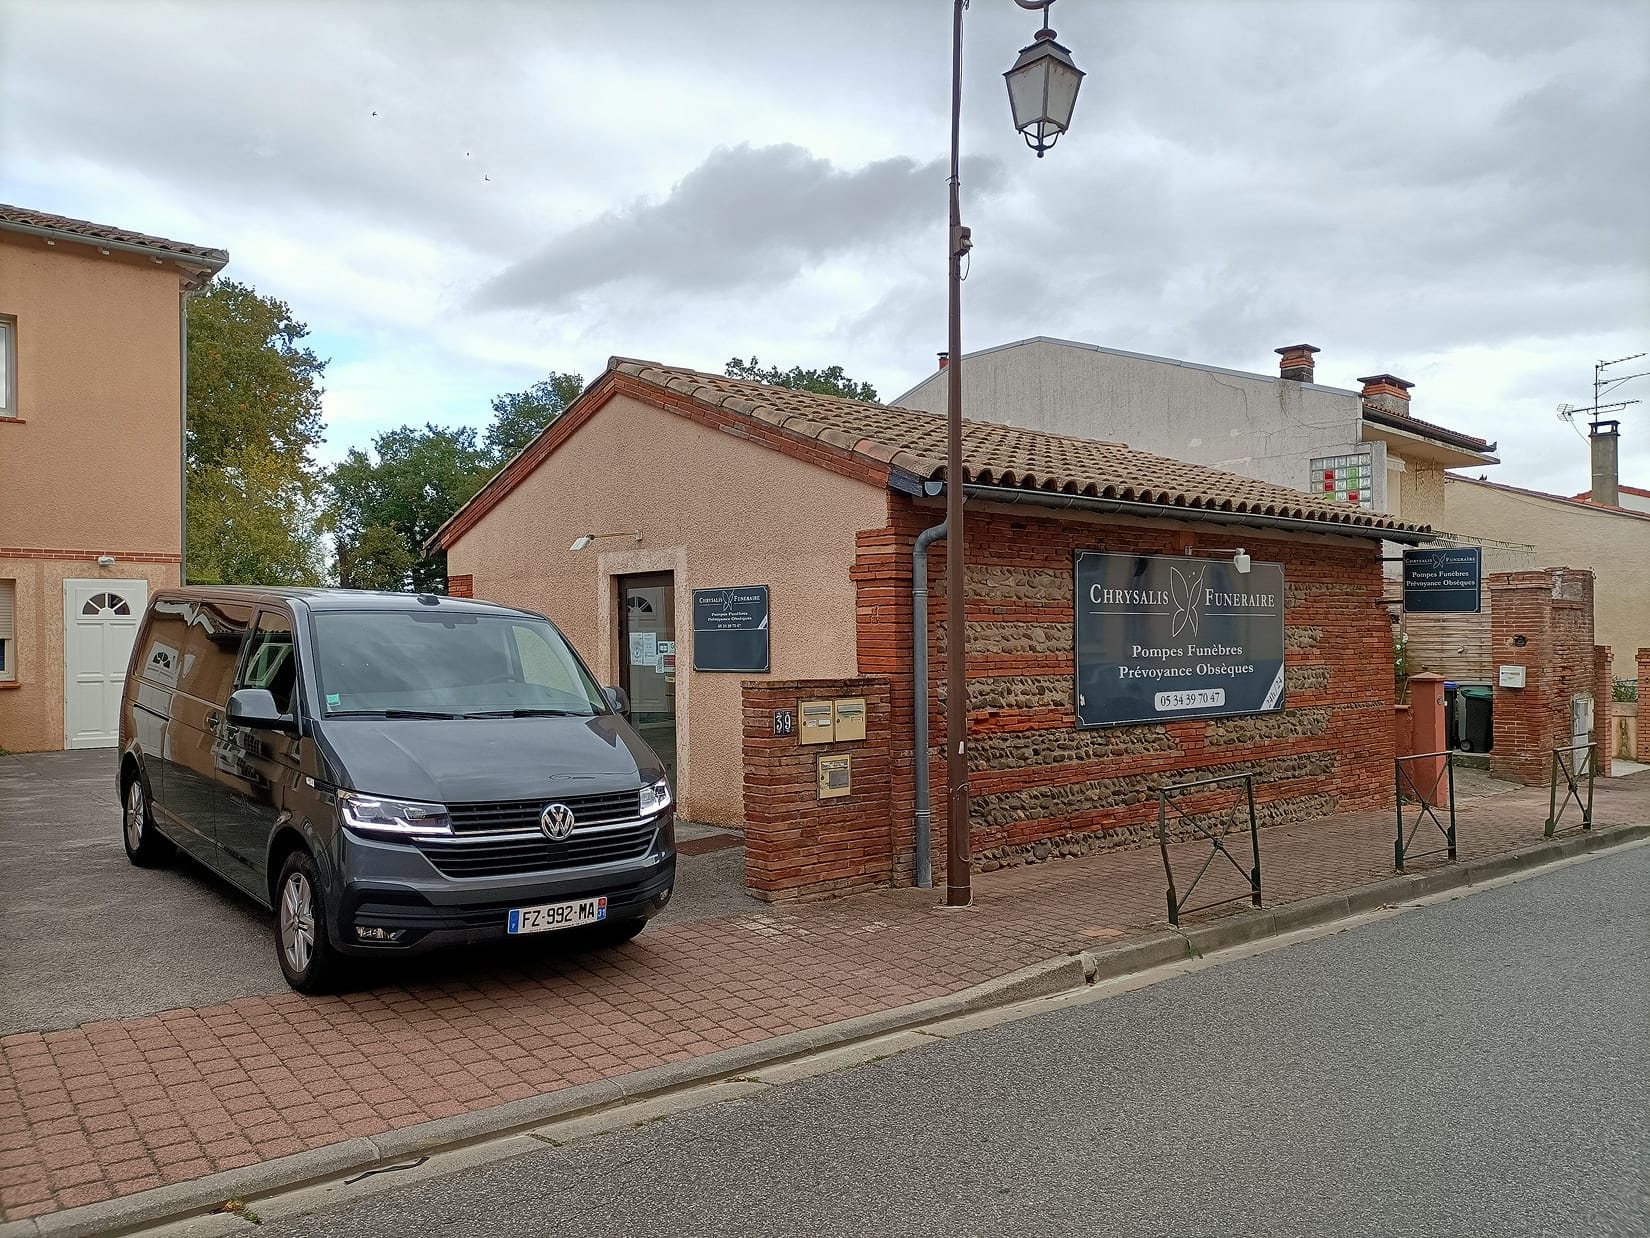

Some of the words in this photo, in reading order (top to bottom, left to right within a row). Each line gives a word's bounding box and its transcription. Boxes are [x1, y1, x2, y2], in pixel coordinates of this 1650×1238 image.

[1411, 571, 1438, 579] Pompes
[1089, 583, 1169, 605] CHRYSALIS
[1204, 588, 1275, 607] FUNERAIRE
[1131, 645, 1183, 661] Pompes
[1187, 643, 1243, 657] Funèbres
[1118, 665, 1193, 681] Prévoyance
[1196, 662, 1254, 678] Obsèques
[1160, 695, 1171, 707] 05
[1173, 694, 1184, 706] 34
[1185, 693, 1196, 706] 39
[1198, 692, 1209, 704] 70
[1210, 691, 1220, 703] 47
[775, 713, 791, 732] 39
[522, 902, 595, 929] FZ-992-MA
